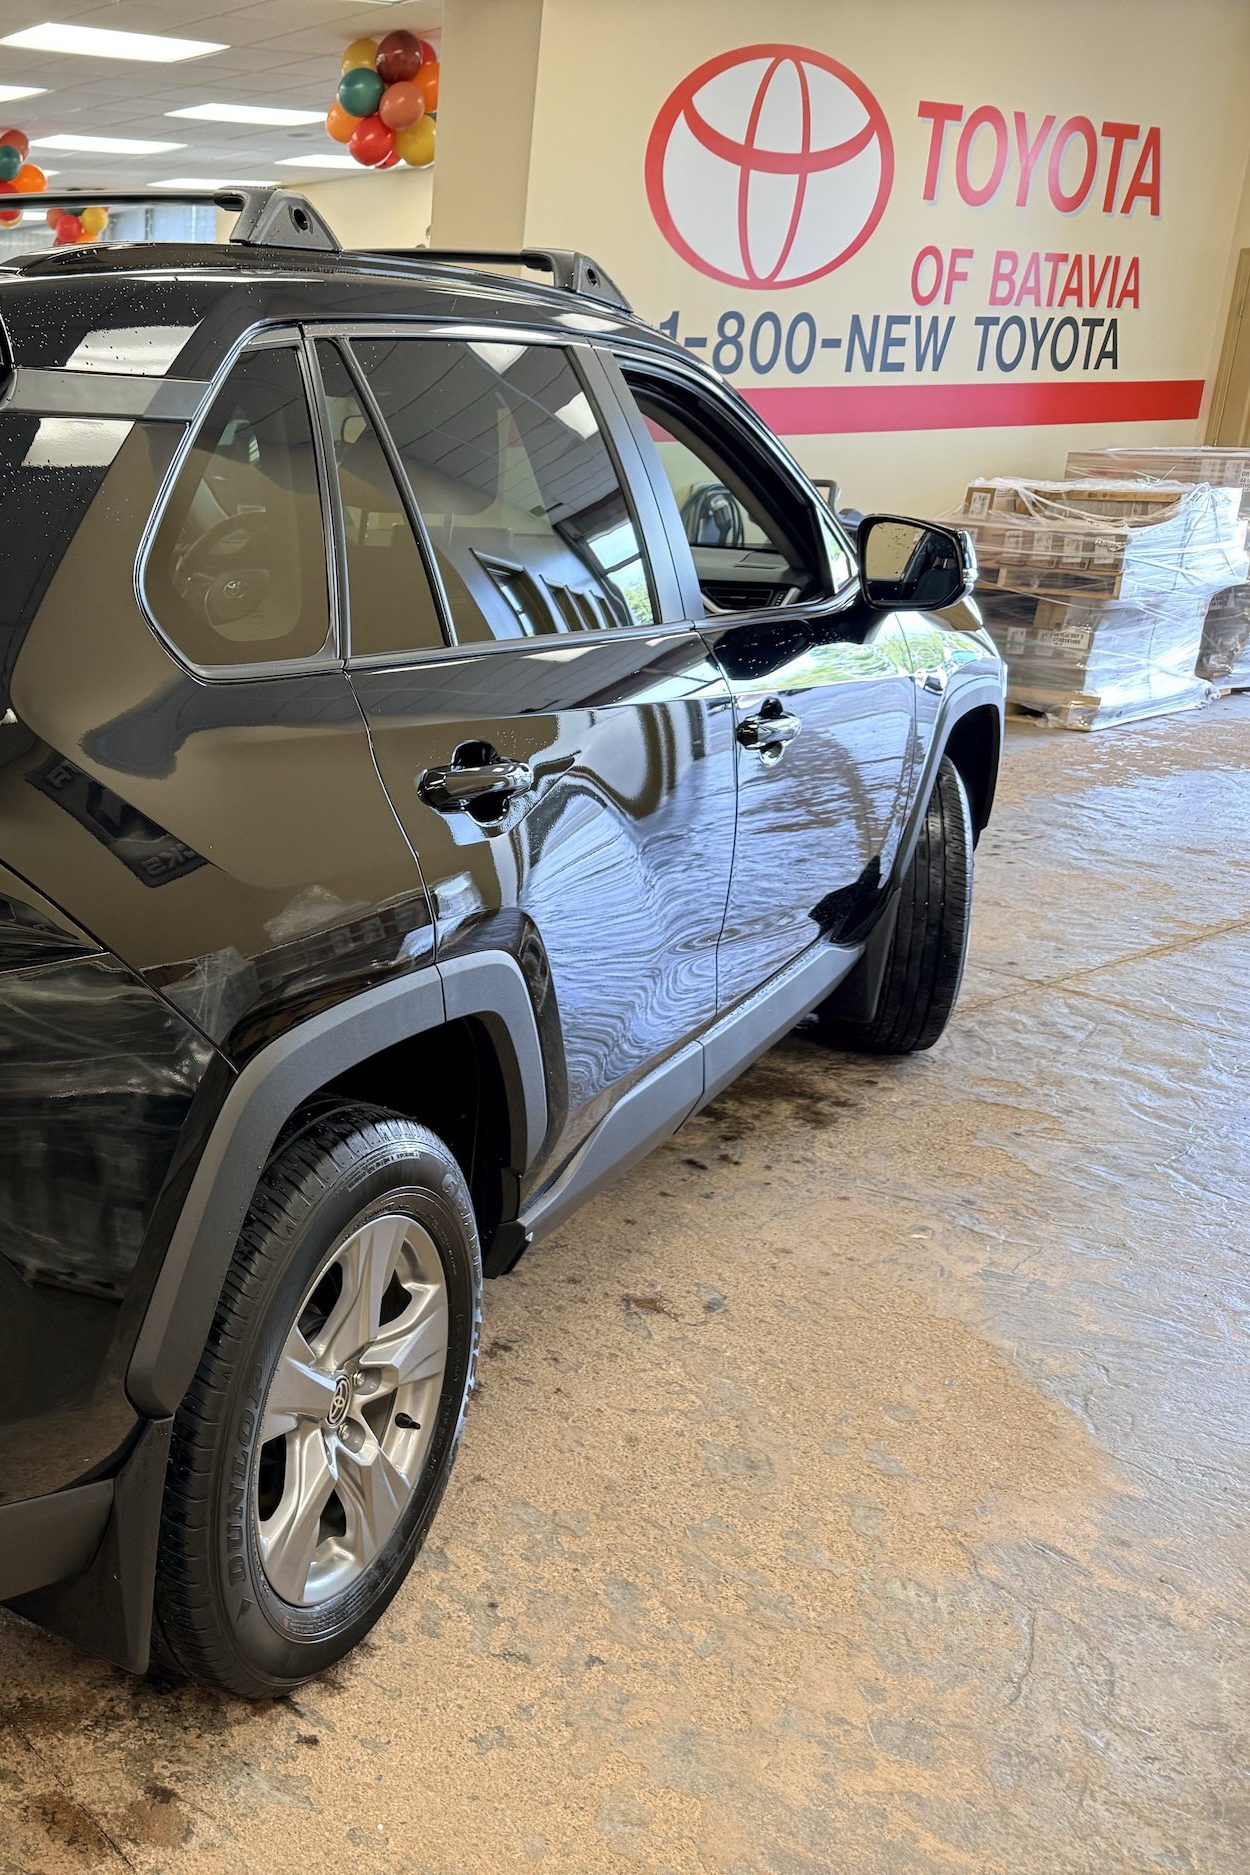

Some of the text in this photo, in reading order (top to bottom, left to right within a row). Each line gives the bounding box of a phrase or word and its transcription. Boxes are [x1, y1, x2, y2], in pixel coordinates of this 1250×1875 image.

[917, 99, 1162, 217] TOYOTA
[911, 245, 1140, 309] OF BATAVIA
[974, 315, 1119, 372] TOYOTA
[226, 1363, 263, 1586] DUNLOP
